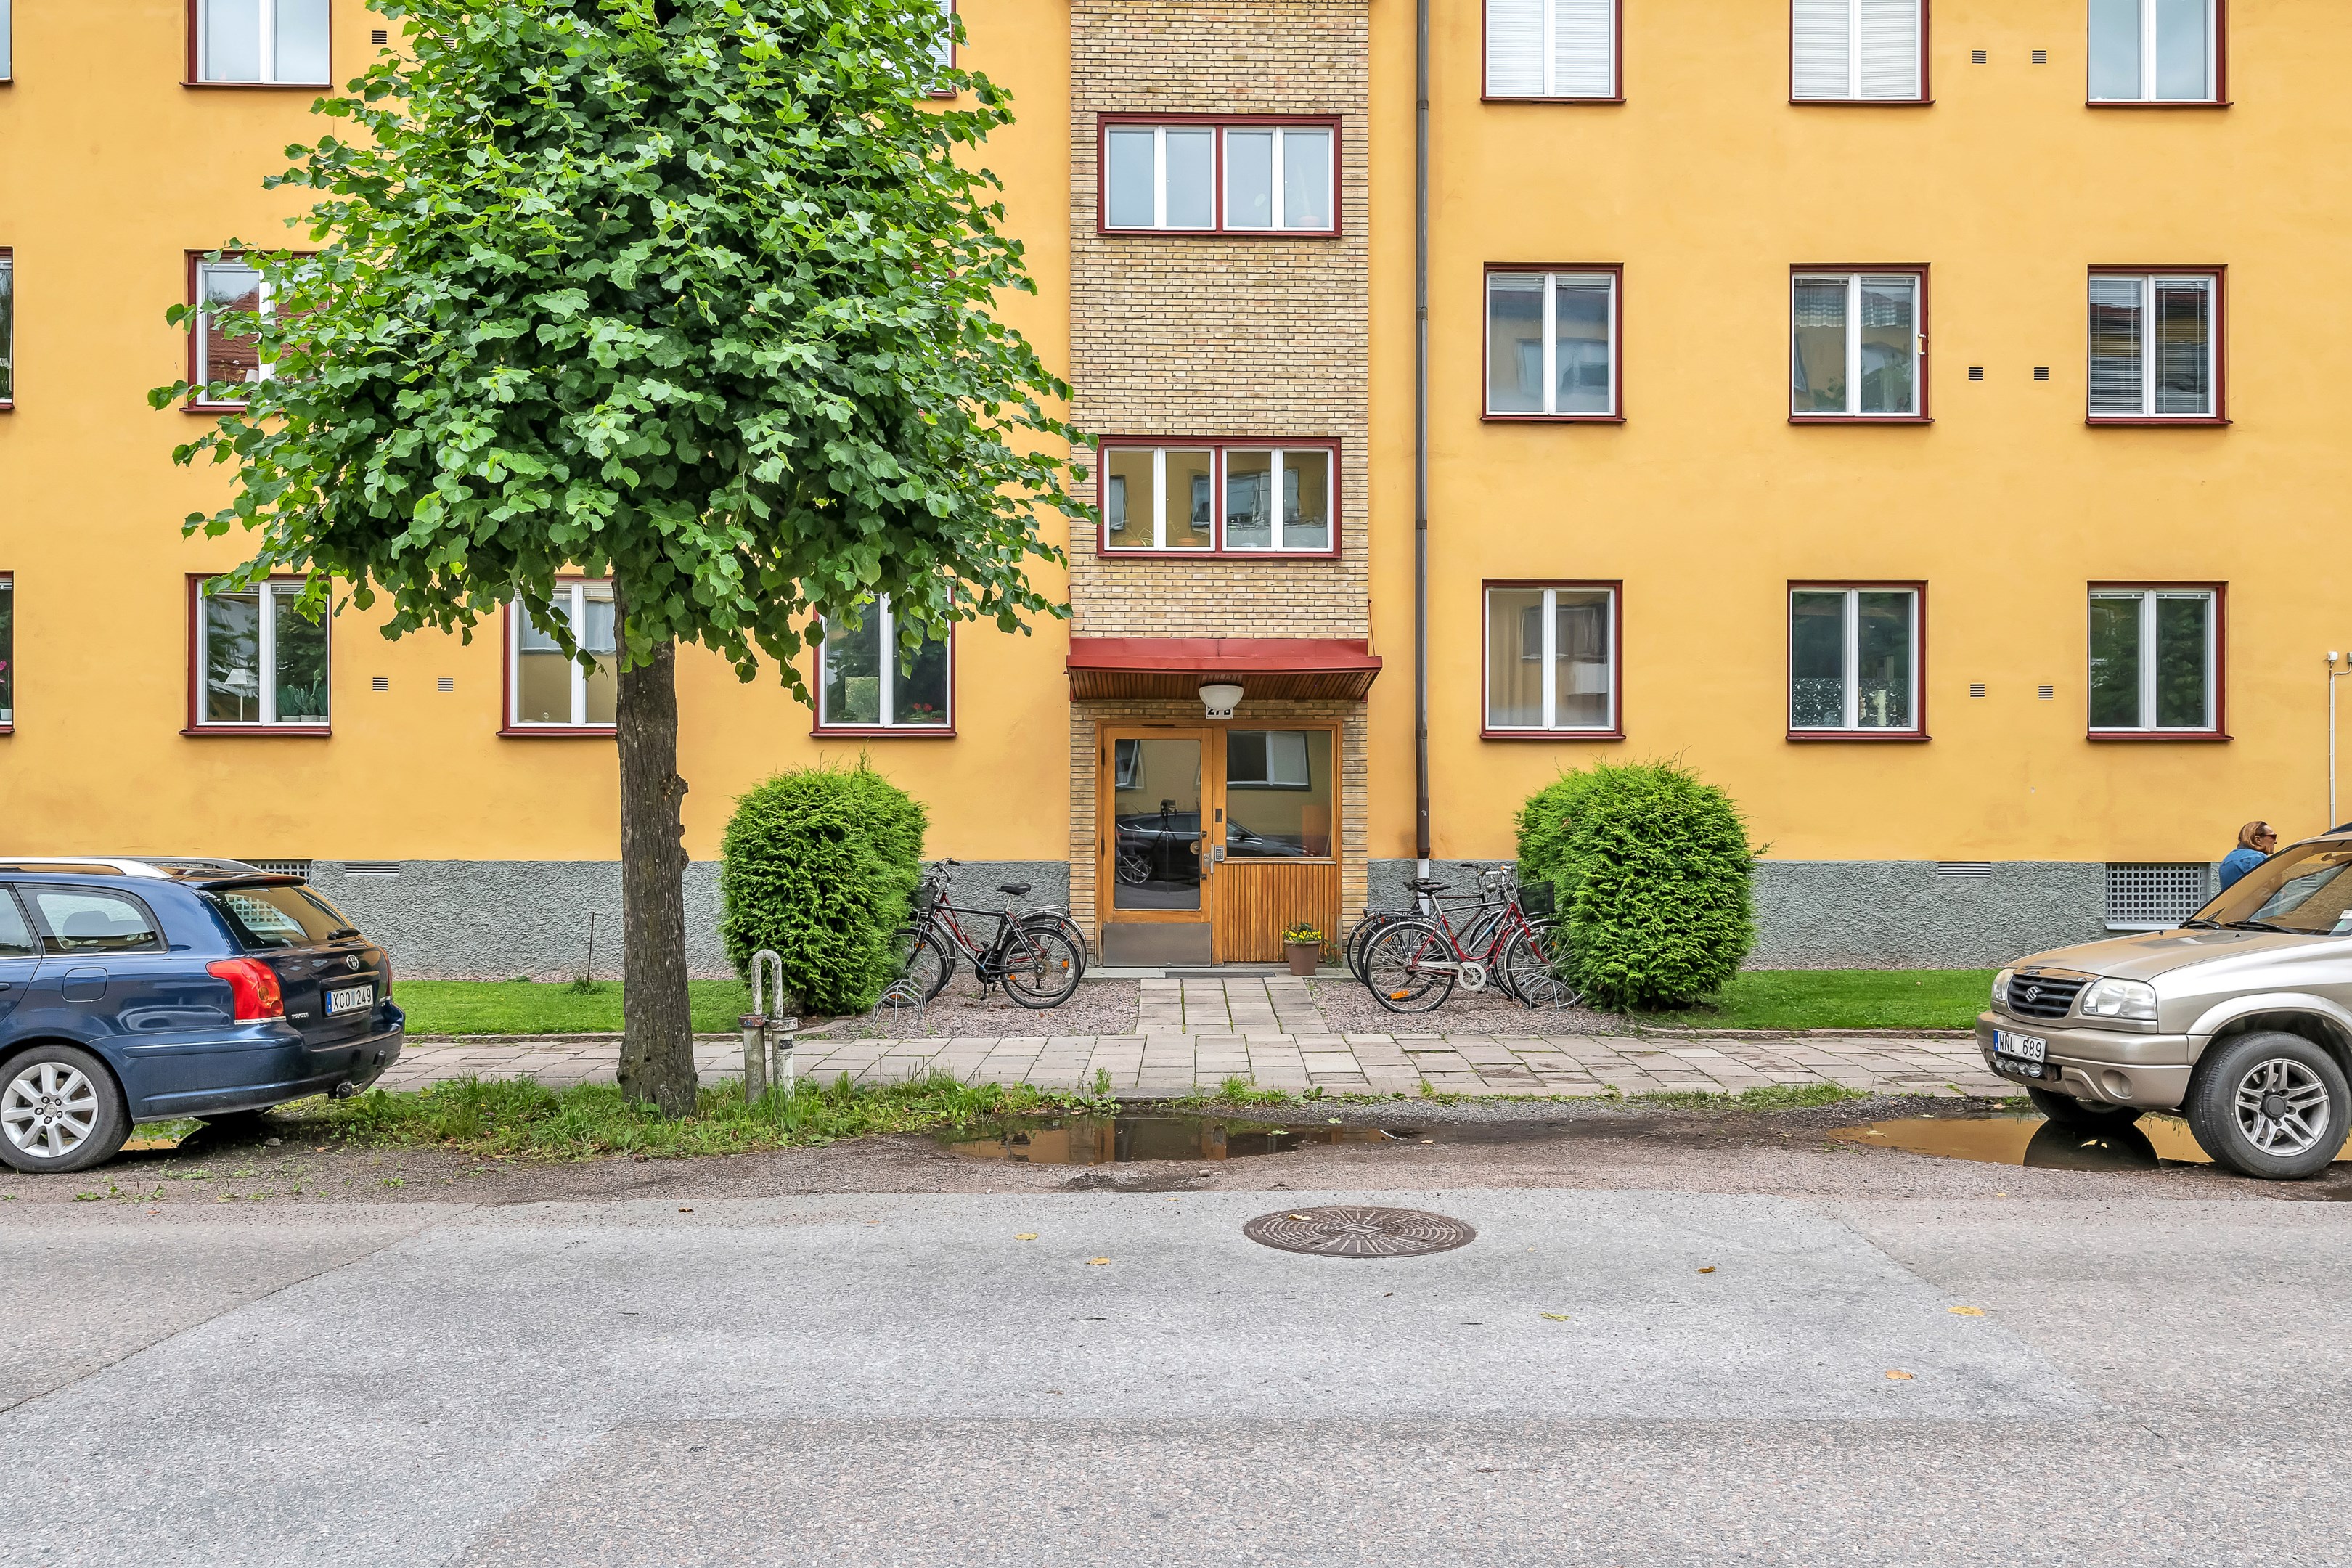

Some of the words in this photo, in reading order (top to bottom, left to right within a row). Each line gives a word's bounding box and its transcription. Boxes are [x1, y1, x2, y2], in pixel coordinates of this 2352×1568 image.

[333, 992, 350, 1009] XCO
[356, 988, 371, 1005] 249
[1999, 1034, 2015, 1053] WNL
[2022, 1039, 2042, 1058] 689
